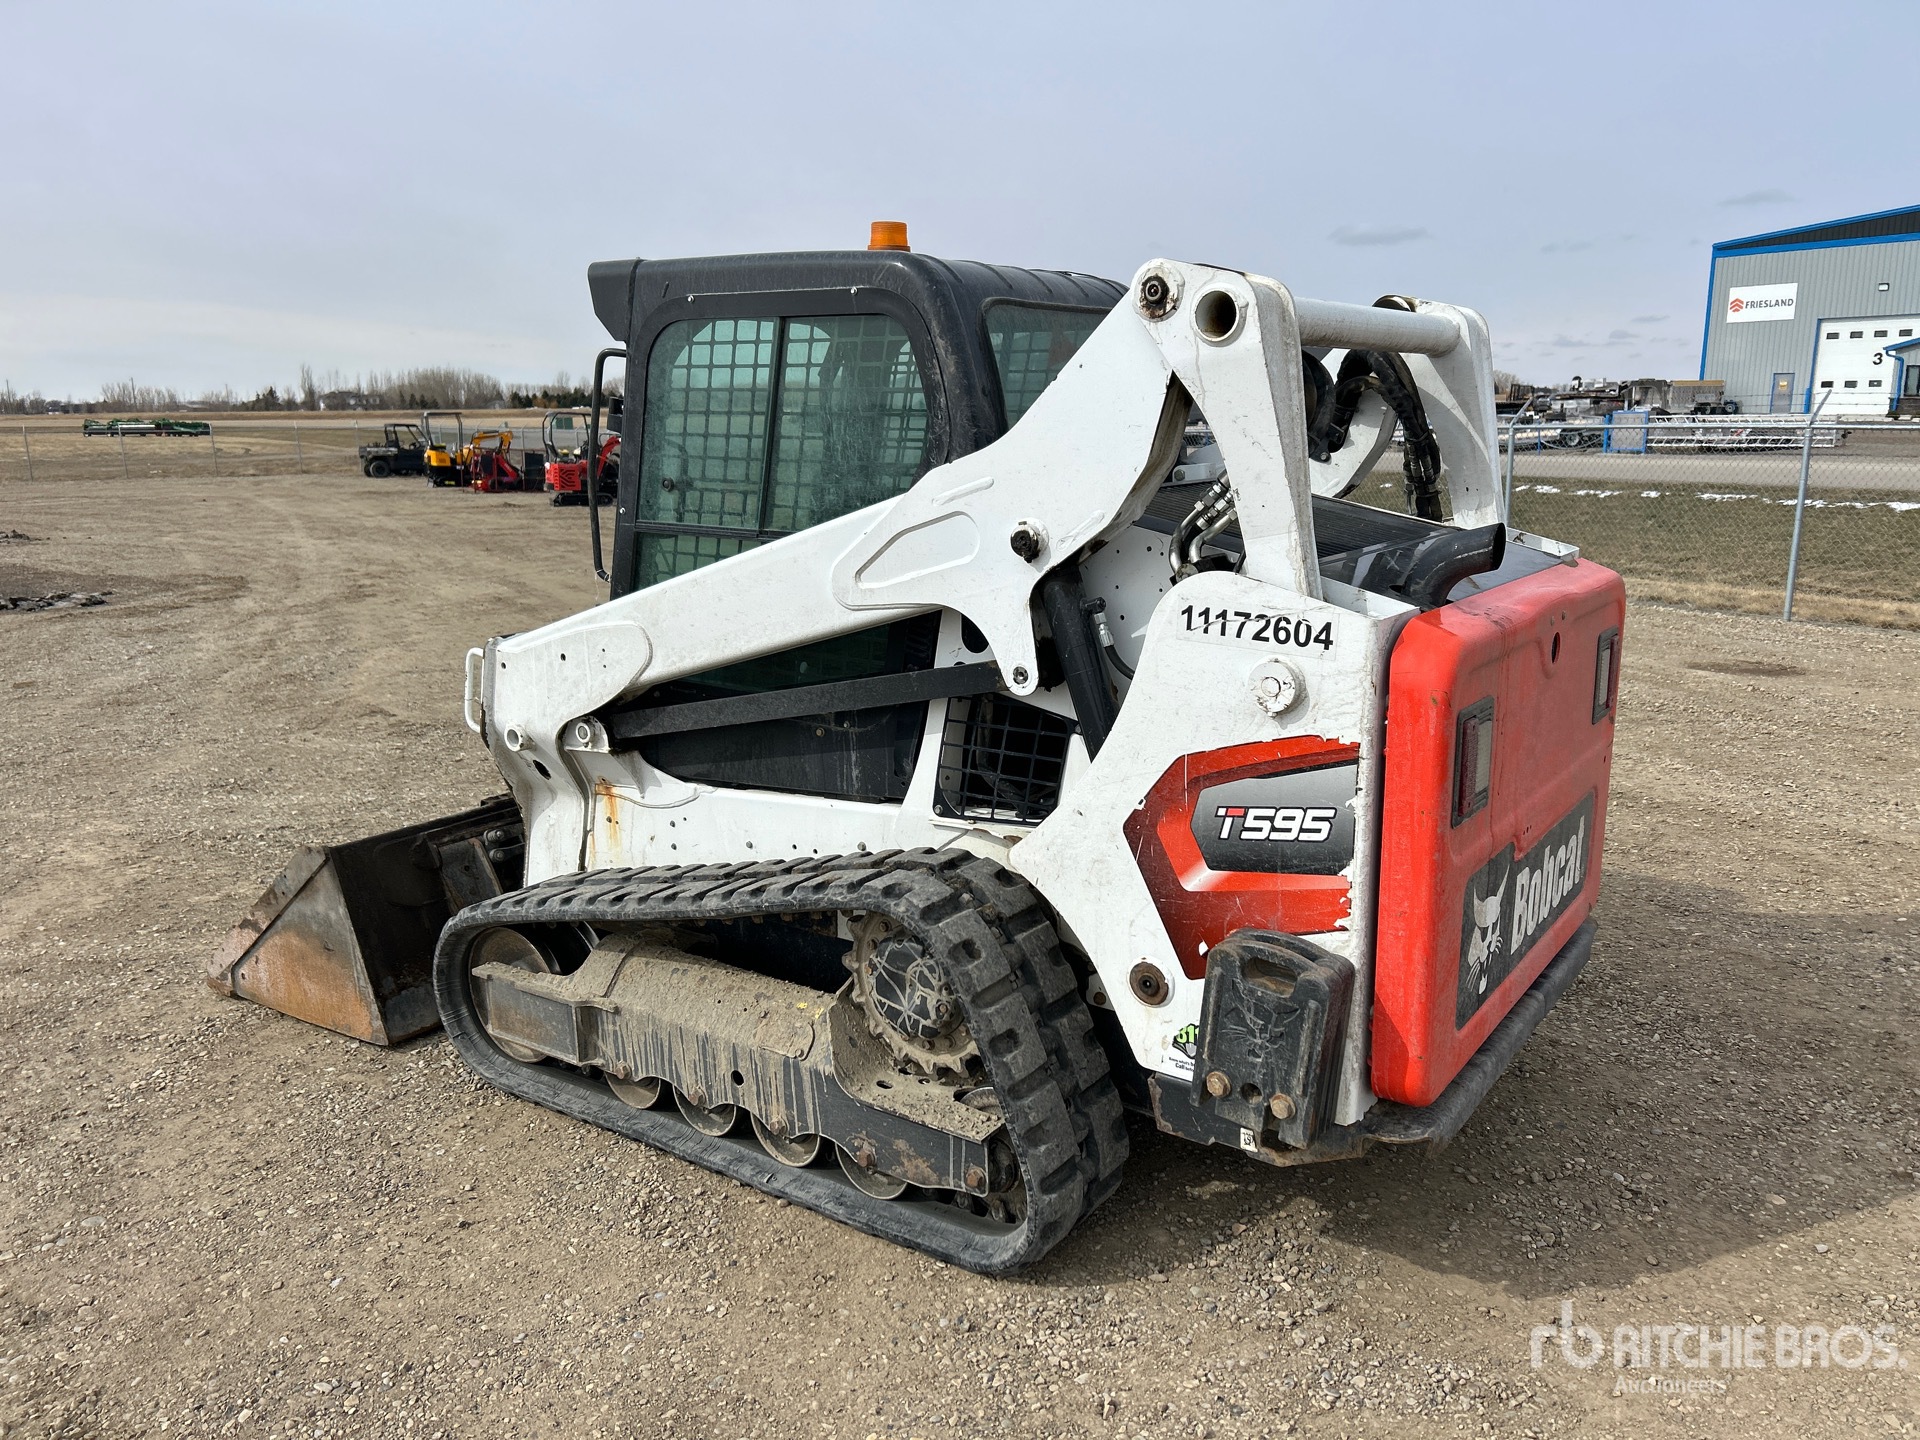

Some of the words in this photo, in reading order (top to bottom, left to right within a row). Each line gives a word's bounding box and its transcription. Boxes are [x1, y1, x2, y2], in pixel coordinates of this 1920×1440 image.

[1745, 298, 1794, 310] FRIESLAND
[1872, 352, 1883, 366] 3
[1181, 605, 1334, 650] 11172604
[1215, 806, 1337, 841] T595
[1511, 815, 1585, 955] Bobcat
